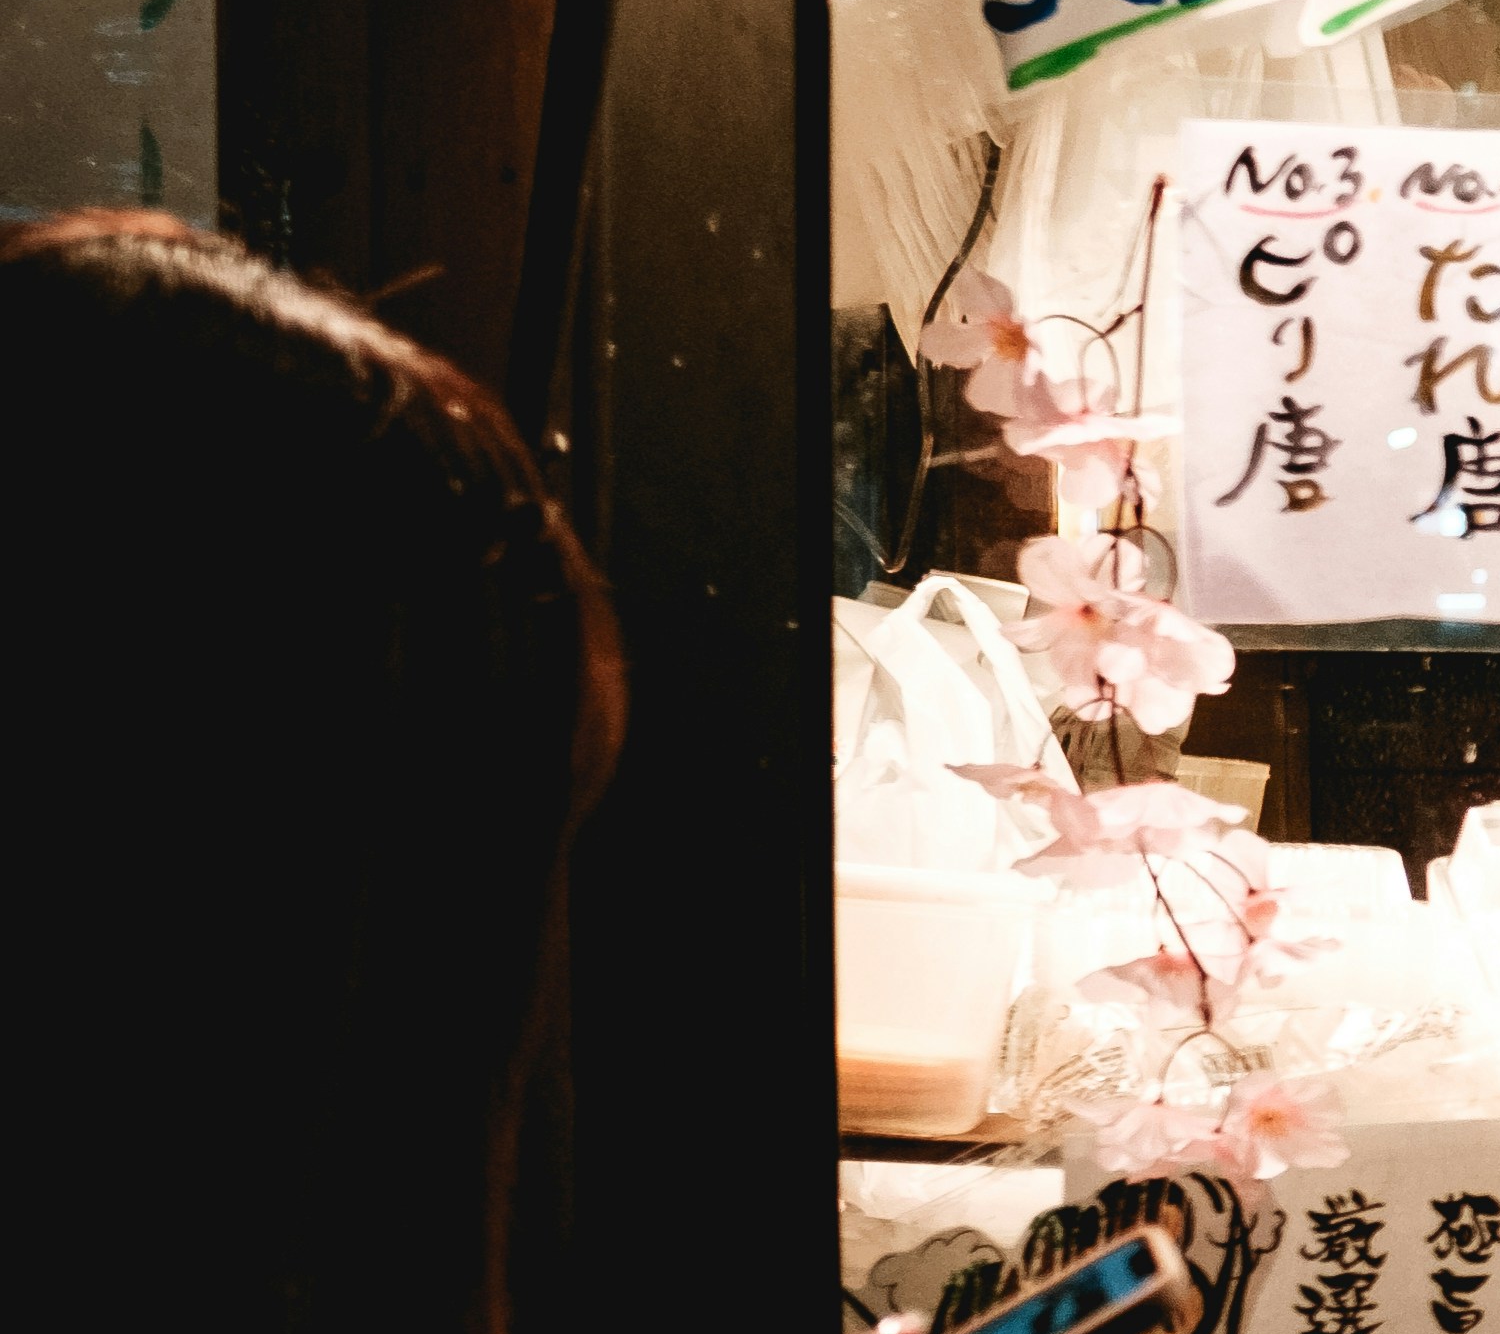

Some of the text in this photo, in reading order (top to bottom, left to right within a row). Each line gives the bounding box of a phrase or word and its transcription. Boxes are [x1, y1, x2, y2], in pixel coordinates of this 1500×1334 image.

[1224, 146, 1365, 202] No.3
[1217, 222, 1361, 513] ピリ唐
